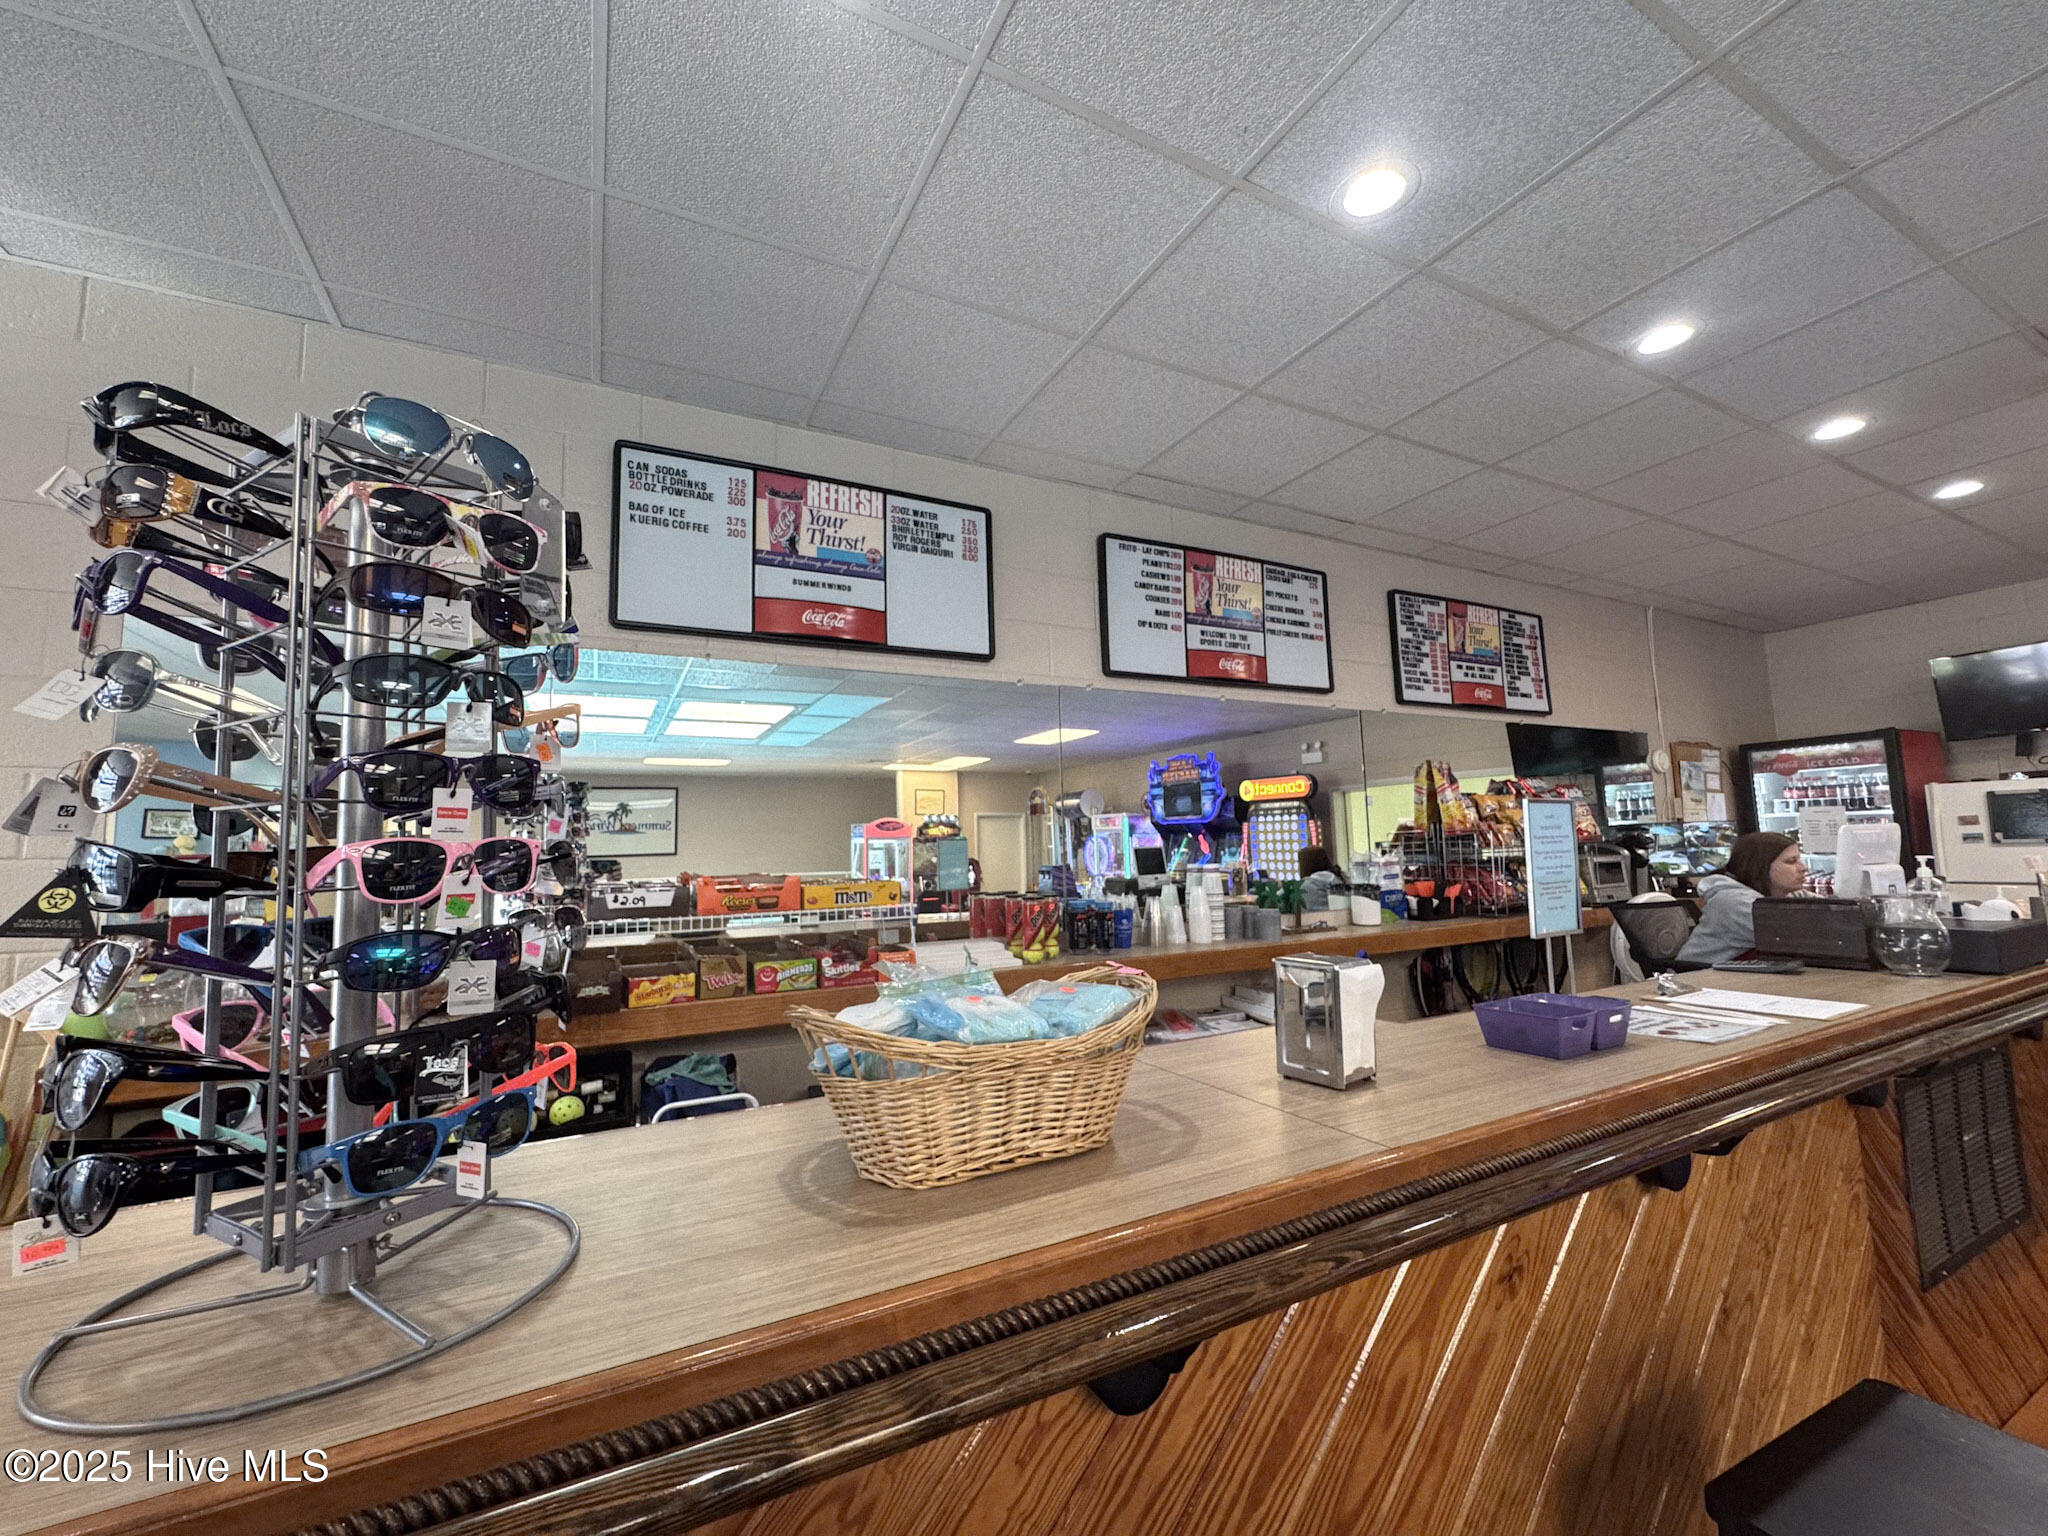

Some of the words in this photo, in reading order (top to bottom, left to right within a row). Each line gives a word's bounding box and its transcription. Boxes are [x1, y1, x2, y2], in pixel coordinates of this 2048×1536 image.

[627, 460, 649, 472] CAN
[655, 465, 688, 478] SODAS
[728, 477, 747, 488] 125
[661, 485, 715, 502] POWERADE
[728, 487, 746, 498] 225
[807, 479, 883, 518] REFRESH
[727, 496, 746, 507] 300
[628, 501, 649, 513] BAG
[652, 506, 665, 515] OF
[669, 508, 686, 518] ICE
[912, 509, 938, 521] WATER
[672, 519, 709, 533] COFFEE
[808, 508, 848, 531] Your
[913, 520, 939, 531] WATER
[727, 528, 747, 539] 200
[807, 527, 866, 552] Thirst!
[893, 533, 908, 543] ROY
[1216, 578, 1242, 595] Your
[1216, 593, 1252, 611] Thirst!
[1200, 630, 1227, 641] WELCOME
[1229, 632, 1237, 640] TO
[1806, 760, 1825, 768] ICE
[1828, 756, 1860, 767] COLD
[612, 894, 646, 906] $2.09
[825, 963, 861, 978] Skittles
[419, 1052, 460, 1077] Locs
